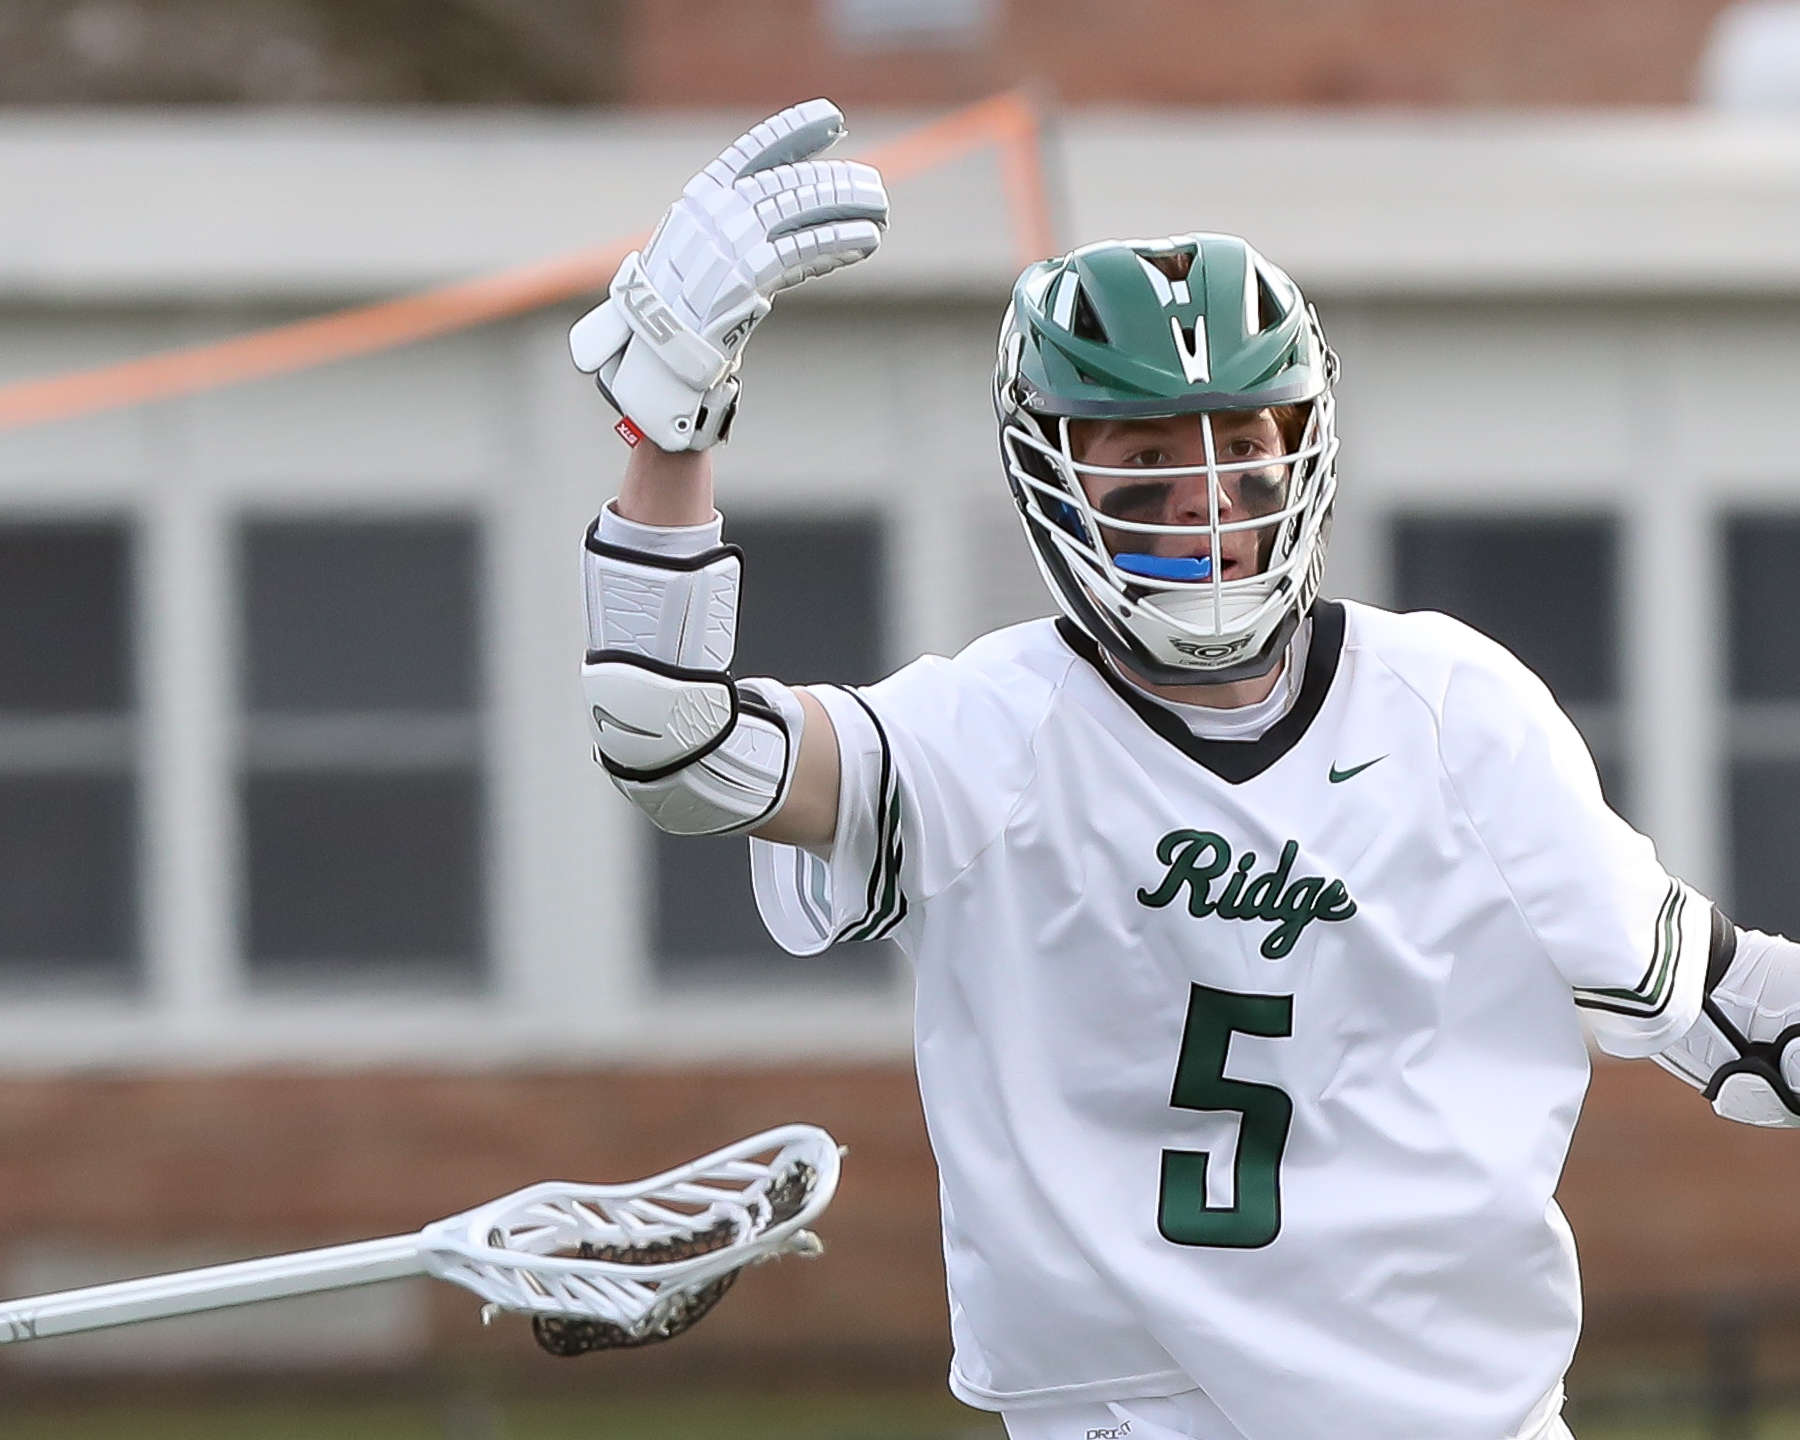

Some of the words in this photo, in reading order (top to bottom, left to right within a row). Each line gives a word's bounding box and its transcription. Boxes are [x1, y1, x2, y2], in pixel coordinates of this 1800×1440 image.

[722, 310, 760, 350] STX
[616, 417, 641, 445] STX
[1136, 829, 1357, 960] Ridge
[1158, 981, 1295, 1249] 5
